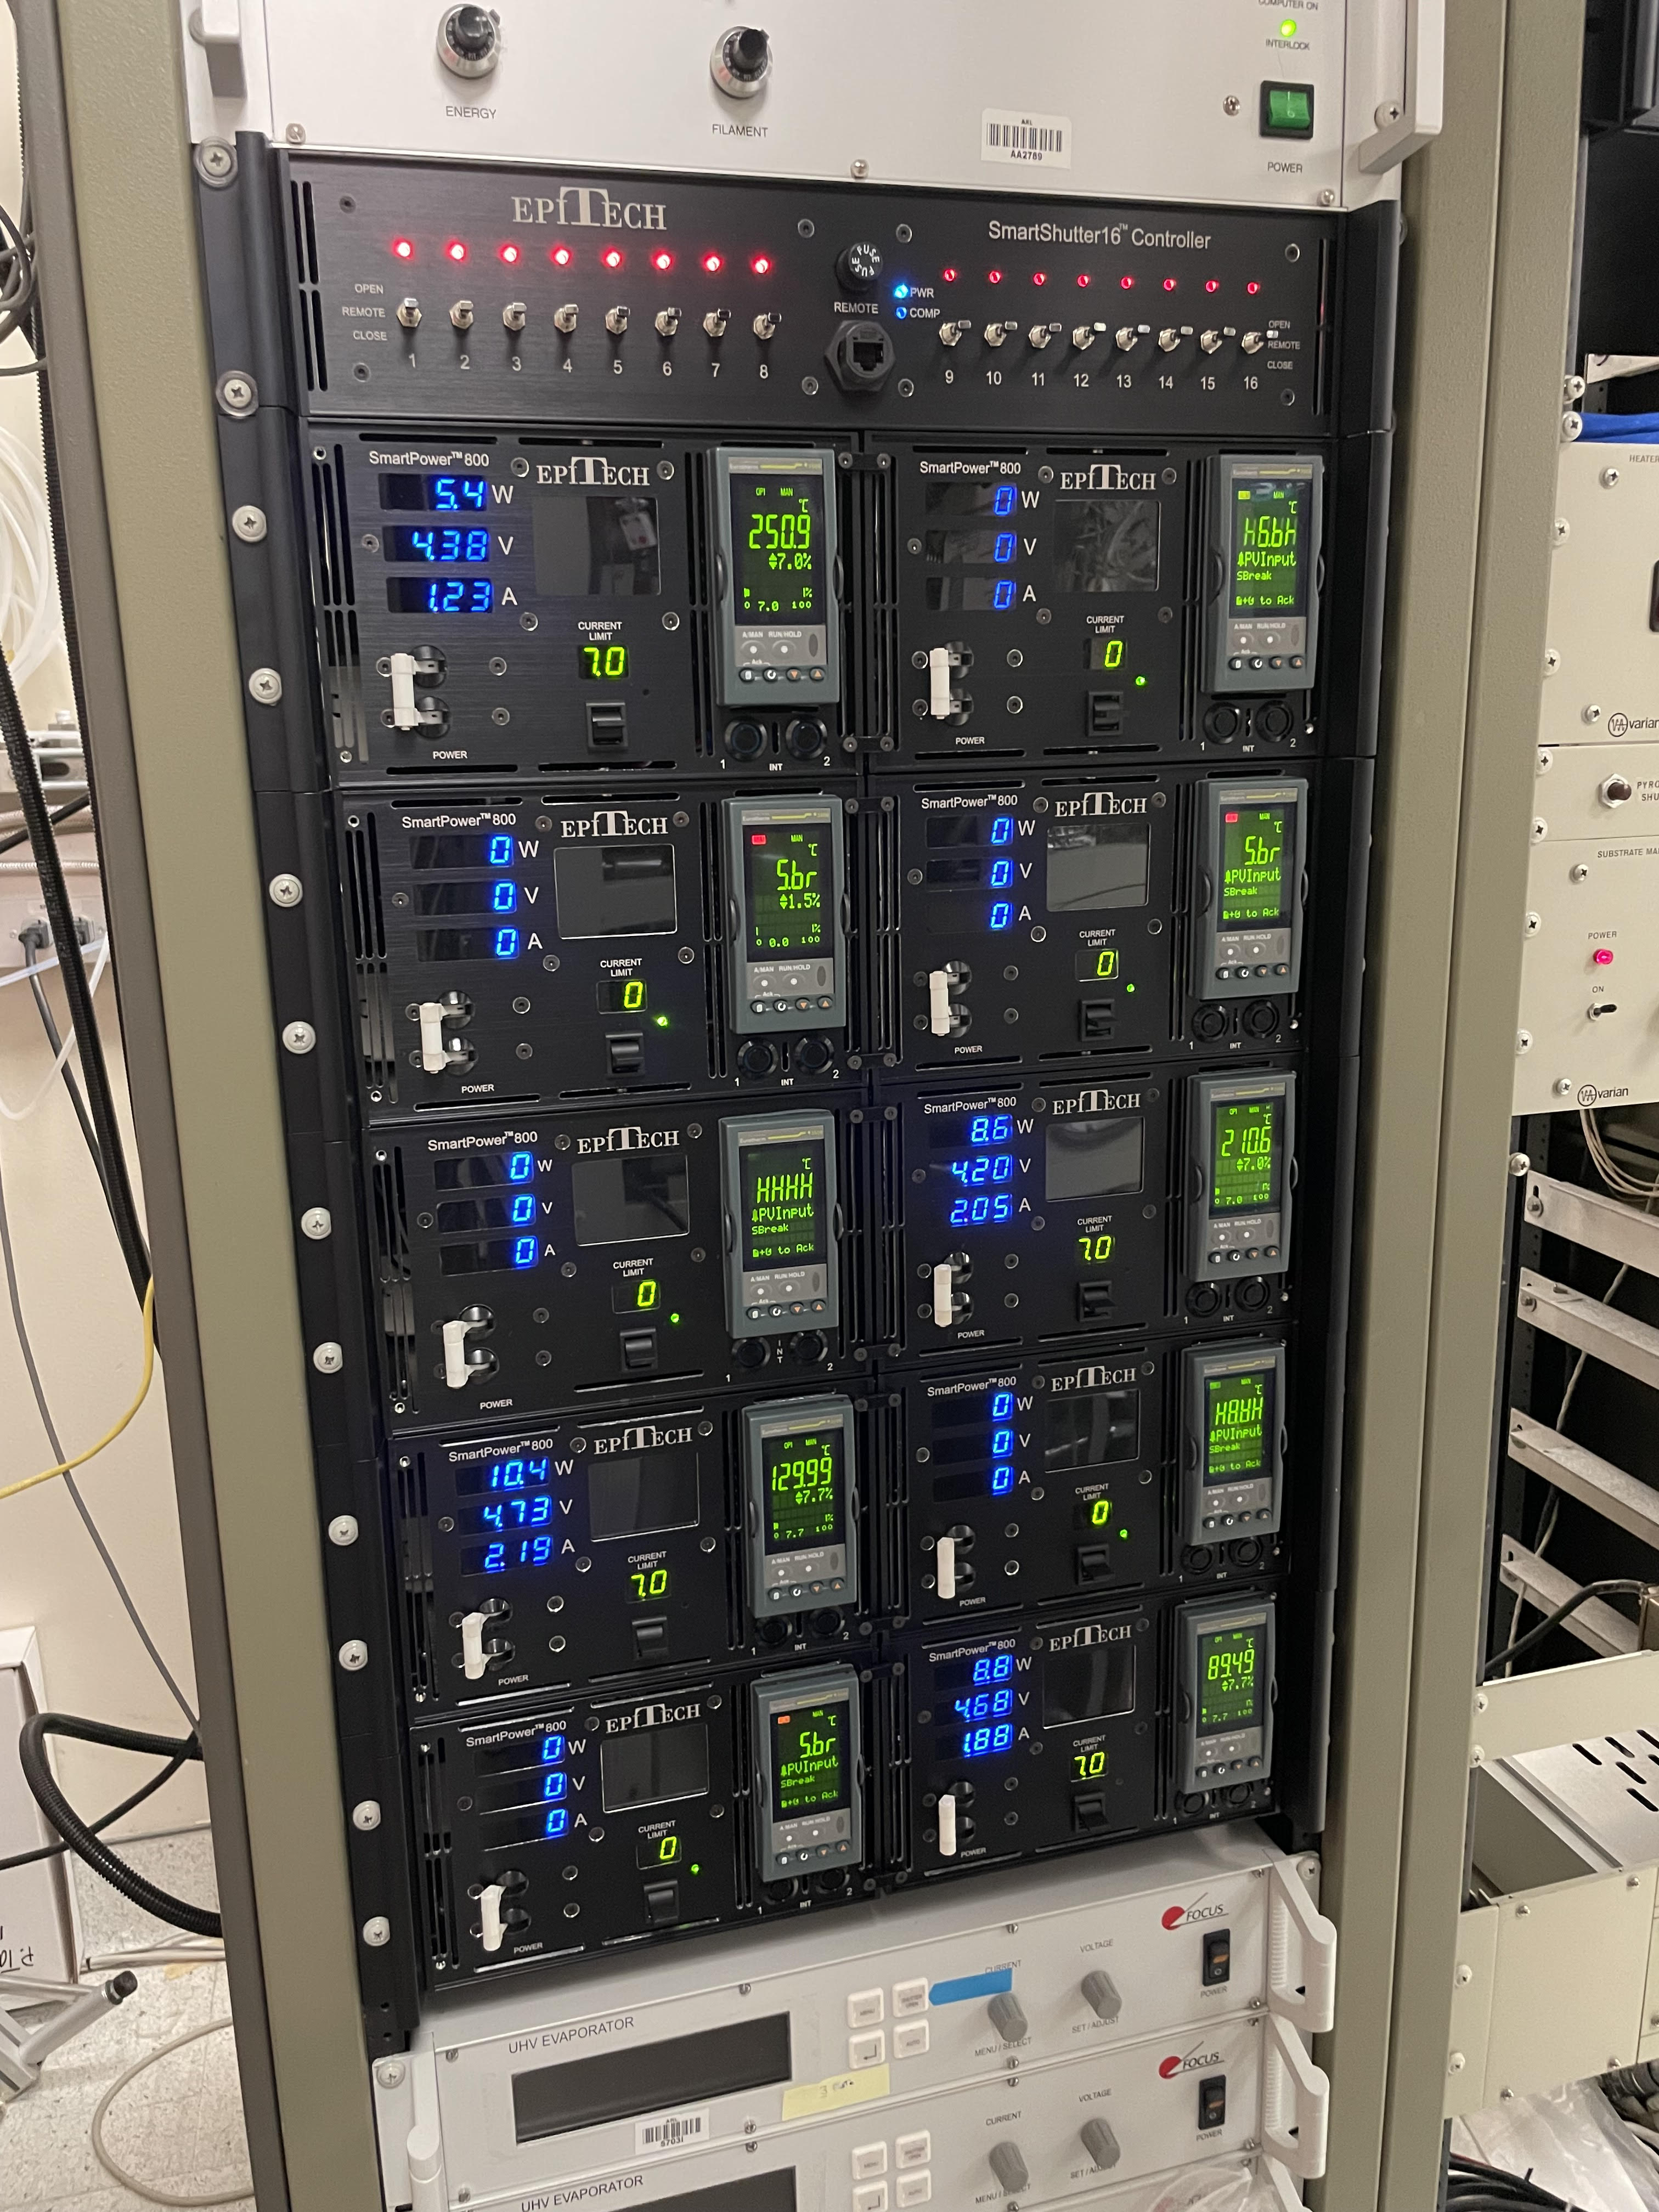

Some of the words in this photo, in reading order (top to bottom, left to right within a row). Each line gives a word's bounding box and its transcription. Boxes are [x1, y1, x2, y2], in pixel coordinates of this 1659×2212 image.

[1306, 2, 1318, 10] ON
[1266, 39, 1310, 50] INTERLOCK
[445, 105, 497, 120] ENERGY
[712, 124, 768, 138] FILAMENT
[1010, 150, 1043, 161] AA2789
[1267, 162, 1302, 173] POWER
[1131, 228, 1211, 249] Controller
[354, 284, 383, 294] OPEN
[910, 286, 934, 298] PWR
[342, 307, 386, 317] REMOTE
[834, 302, 878, 315] REMOTE
[910, 308, 940, 319] COMP
[1268, 320, 1290, 329] OPEN
[353, 331, 387, 341] CLOSE
[1267, 341, 1300, 350] REMOTE
[409, 353, 416, 368] 1
[460, 355, 470, 370] 2
[512, 357, 521, 371] 3
[562, 358, 572, 373] 4
[613, 360, 623, 374] 5
[662, 362, 672, 376] 6
[712, 363, 721, 377] 7
[759, 365, 769, 379] 8
[1267, 360, 1293, 370] CLOSE
[945, 370, 953, 383] 9
[986, 371, 1001, 385] 10
[1031, 372, 1045, 386] 11
[1074, 374, 1089, 387] 12
[1117, 374, 1132, 388] 13
[1159, 376, 1173, 389] 14
[1200, 376, 1215, 391] 15
[1244, 377, 1258, 390] 16
[436, 478, 487, 510] 5.4
[492, 484, 514, 504] W
[994, 486, 1014, 516] 0
[749, 514, 811, 549] 250.9
[411, 529, 489, 561] 4.38
[498, 536, 514, 555] V
[994, 533, 1013, 562] 0
[428, 581, 491, 613] 1.23
[501, 587, 517, 606] A
[993, 579, 1013, 610] 0
[578, 621, 622, 630] CURRENT
[589, 633, 612, 641] LIMIT
[583, 646, 625, 678] 7.0
[433, 751, 467, 760] POWER
[991, 817, 1009, 845] 0
[489, 836, 510, 864] 0
[1598, 849, 1643, 858] SUBSTRATE
[991, 861, 1009, 887] 0
[493, 882, 514, 911] 0
[1224, 887, 1257, 896] SBreak
[990, 903, 1009, 929] 0
[495, 928, 516, 956] 0
[1588, 931, 1617, 939] POWER
[1598, 1087, 1628, 1098] varian
[971, 1115, 1009, 1143] 8.6
[1221, 1126, 1271, 1156] 210.6
[510, 1153, 530, 1180] 0
[952, 1155, 1010, 1184] 4.20
[512, 1195, 532, 1222] 0
[950, 1194, 1009, 1224] 2.05
[752, 1223, 788, 1235] SBreak
[1077, 1215, 1113, 1226] CURRENT
[1085, 1224, 1104, 1233] LIMIT
[516, 1238, 535, 1263] 0
[1079, 1235, 1111, 1261] 7.0
[613, 1258, 654, 1270] CURRENT
[623, 1268, 645, 1278] LIMIT
[957, 1330, 985, 1340] POWER
[479, 1398, 513, 1410] POWER
[992, 1393, 1010, 1418] 0
[992, 1431, 1009, 1453] 0
[491, 1458, 548, 1488] 10.4
[772, 1457, 832, 1491] 129.99
[992, 1467, 1009, 1490] 0
[483, 1496, 549, 1530] 4.73
[484, 1537, 551, 1570] 2.19
[973, 1655, 1009, 1683] 8.8
[955, 1689, 1009, 1719] 4.68
[543, 1736, 561, 1760] 0
[545, 1773, 563, 1797] 0
[781, 1775, 815, 1788] SBreak
[548, 1809, 565, 1832] 0
[1186, 1904, 1224, 1921] FOCUS
[1080, 1938, 1114, 1953] VOLTAGE
[985, 1960, 1022, 1974] CURRENT
[1200, 1985, 1228, 1999] POWER
[509, 2036, 538, 2055] UHV
[541, 2016, 634, 2048] EVAPORATOR
[1072, 2023, 1086, 2034] SET
[974, 2043, 997, 2057] MENU
[1003, 2036, 1032, 2052] SELECT
[1182, 2052, 1220, 2069] FOCUS
[1078, 2089, 1112, 2103] VOLTAGE
[985, 2111, 1022, 2126] CURRENT
[1196, 2129, 1223, 2142] POWER
[521, 2194, 550, 2212] UHV
[553, 2175, 644, 2207] EVAPORATOR
